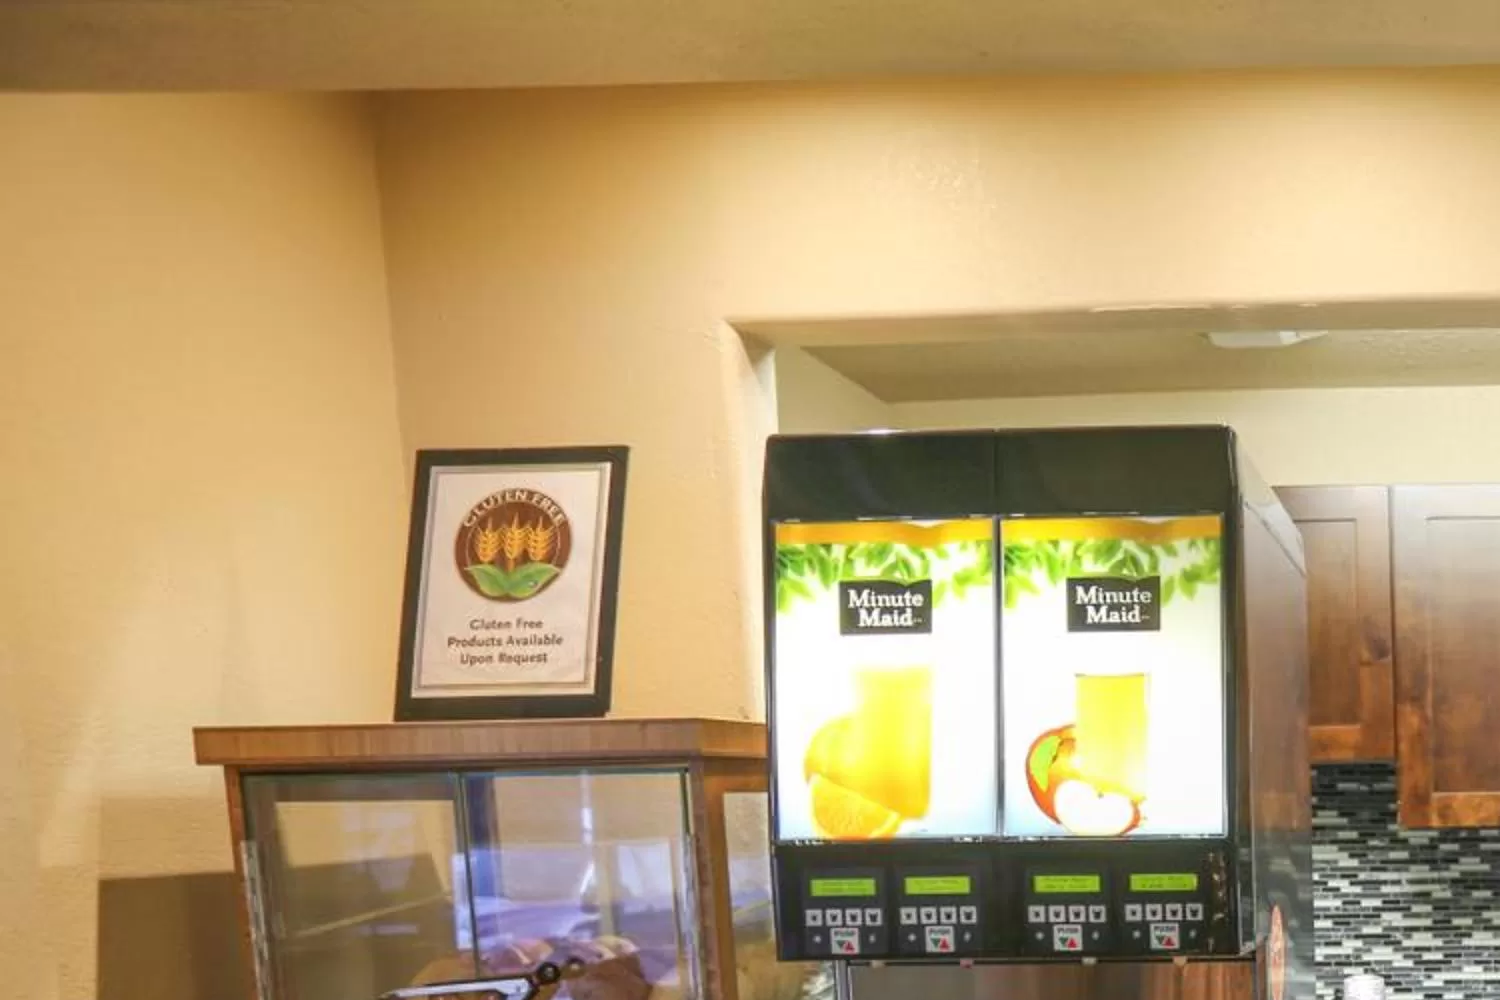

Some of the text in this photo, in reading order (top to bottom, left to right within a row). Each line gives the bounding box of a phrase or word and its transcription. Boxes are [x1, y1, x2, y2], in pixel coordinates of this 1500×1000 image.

[463, 490, 566, 526] GLUTEN FREE
[848, 589, 924, 609] Minute
[1075, 585, 1152, 605] Minute
[469, 618, 544, 630] Gluten Free
[858, 607, 914, 627] Maid
[1086, 604, 1141, 624] Maid
[447, 633, 563, 648] Products Available
[460, 652, 548, 666] Upon Request
